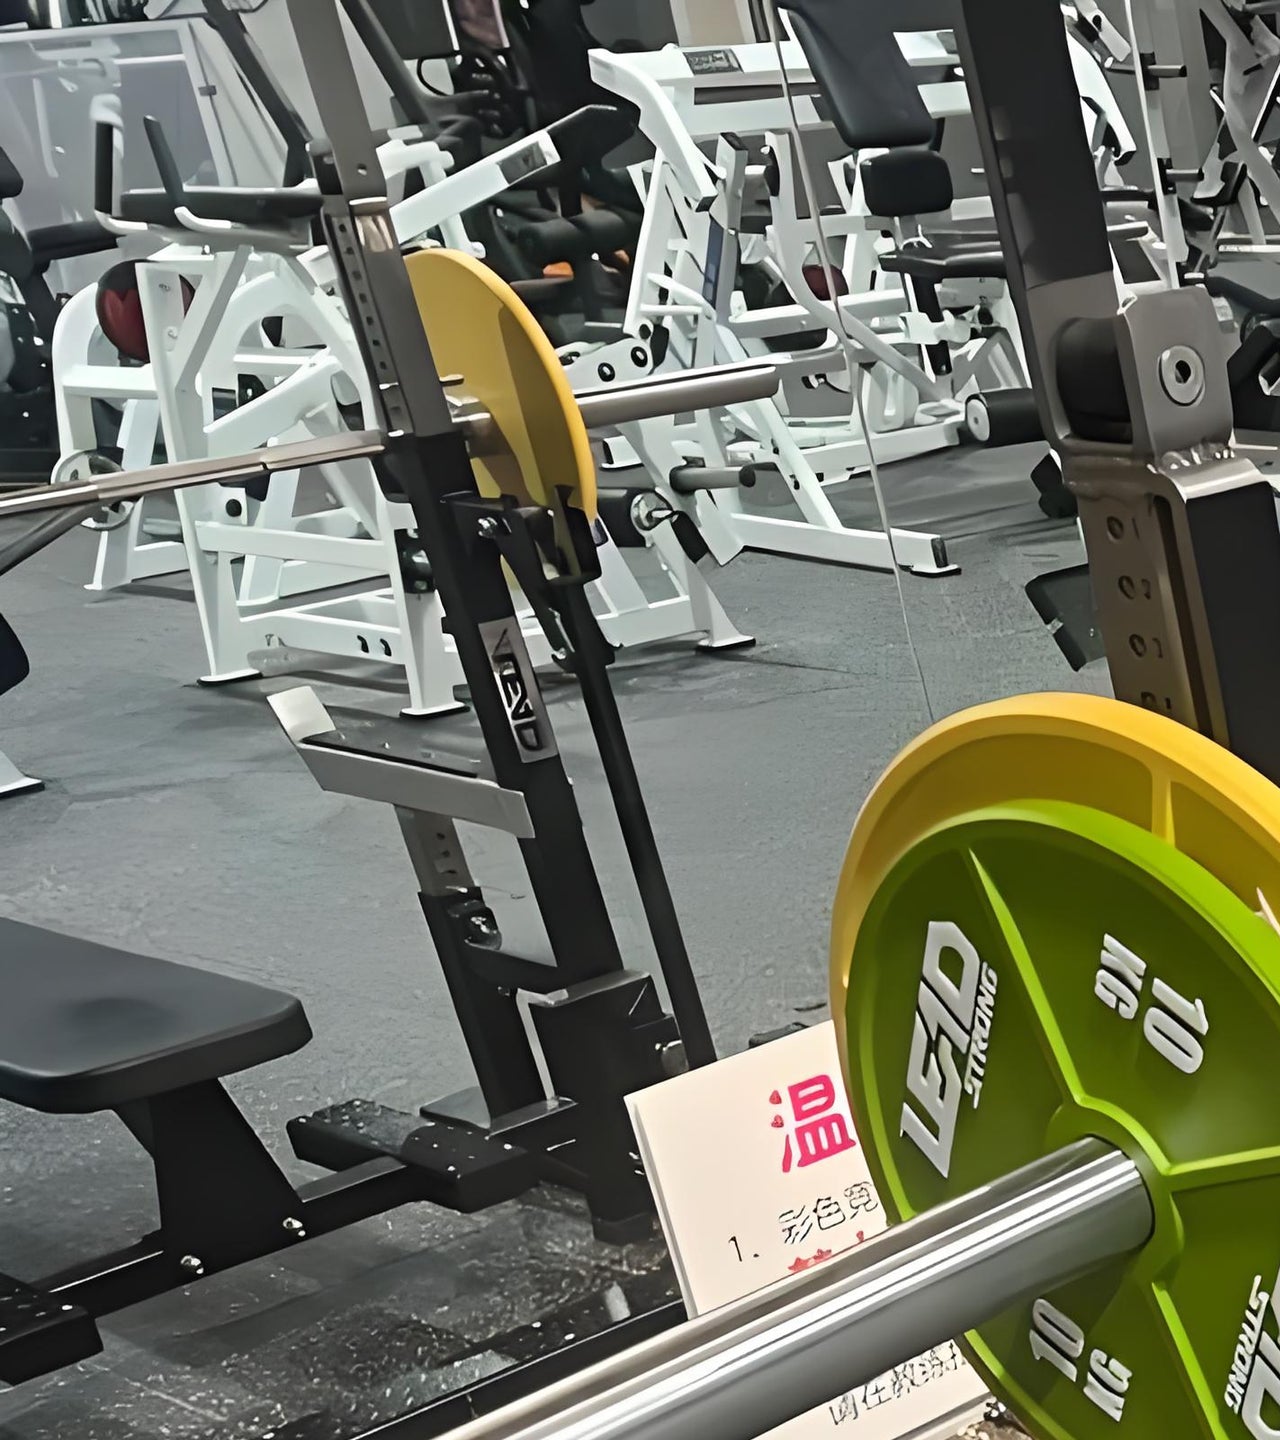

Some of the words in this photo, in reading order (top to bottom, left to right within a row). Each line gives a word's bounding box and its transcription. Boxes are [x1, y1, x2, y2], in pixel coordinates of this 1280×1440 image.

[1094, 933, 1147, 1020] KG
[900, 920, 981, 1179] LEAD
[964, 961, 999, 1110] STRONG
[1143, 977, 1210, 1074] 10
[768, 1074, 856, 1173] 温
[727, 1235, 760, 1262] 1.
[1028, 1298, 1086, 1383] 10
[1083, 1348, 1133, 1423] KG
[1224, 1274, 1270, 1415] STRONG
